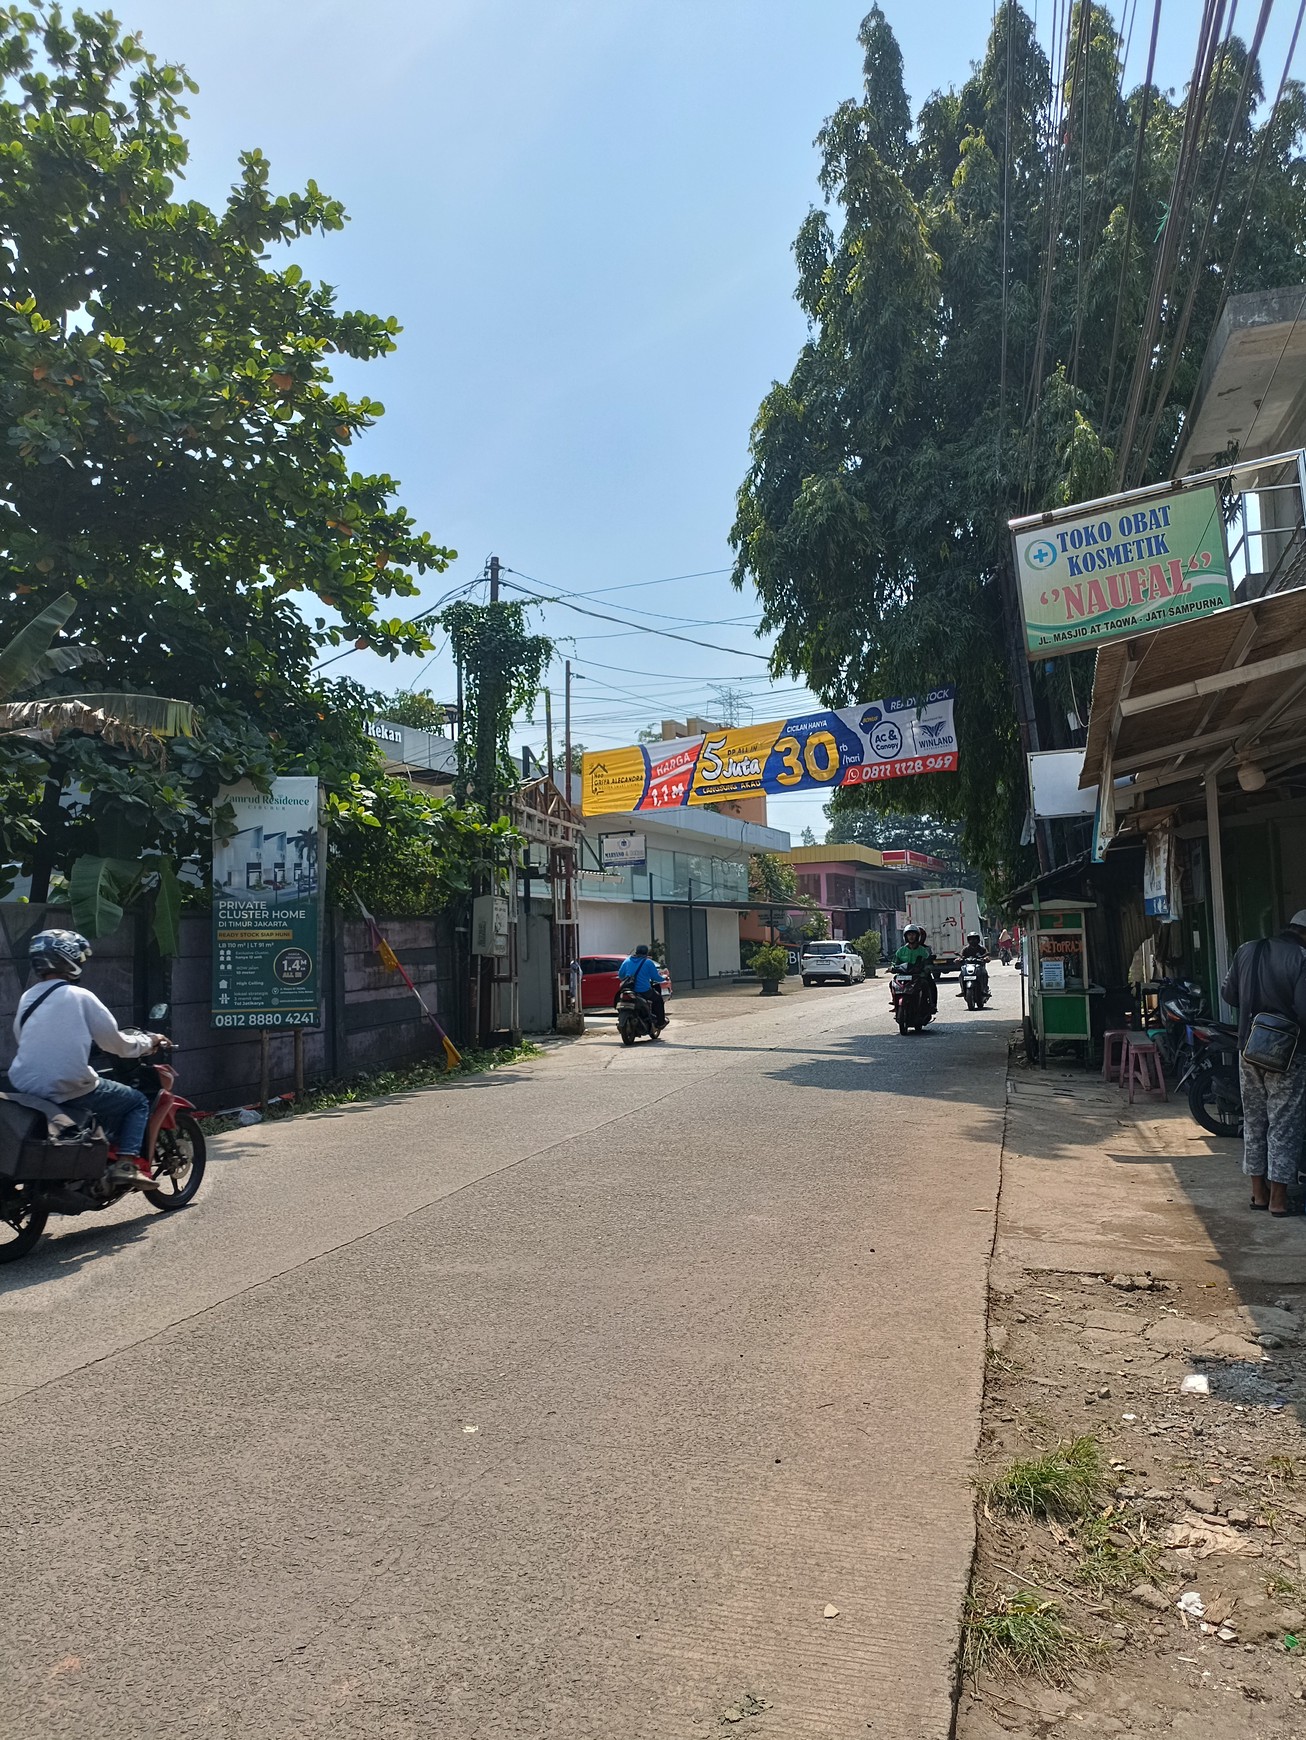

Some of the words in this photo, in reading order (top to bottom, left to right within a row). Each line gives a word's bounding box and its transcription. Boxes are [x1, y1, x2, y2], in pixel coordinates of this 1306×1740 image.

[1056, 521, 1112, 553] TOKO
[1118, 504, 1171, 537] OBAT
[1067, 532, 1170, 577] KOSMETIK
[1038, 634, 1051, 646] JL.
[1053, 626, 1088, 643] MASJID
[1090, 622, 1102, 635] AT
[1104, 615, 1138, 632] TAQWA
[1145, 608, 1166, 622] JATI
[1168, 596, 1224, 617] SAMPURNA
[808, 719, 828, 730] HANYA
[875, 733, 887, 744] AC
[887, 729, 898, 741] &
[918, 735, 954, 749] WINLAND
[839, 743, 849, 752] rb
[875, 742, 899, 751] Canopy
[656, 752, 691, 776] HARGA
[701, 734, 729, 781] 5
[772, 730, 840, 787] 30
[842, 753, 861, 766] /hari
[740, 779, 761, 790] AKAD
[262, 794, 310, 806] Residence
[219, 900, 267, 910] PRIVATE
[218, 910, 270, 919] CLUSTER
[272, 910, 306, 919] HOME
[282, 959, 301, 971] 1.4
[215, 1014, 246, 1027] 0812
[248, 1013, 282, 1025] 8880
[285, 1012, 314, 1024] 4241
